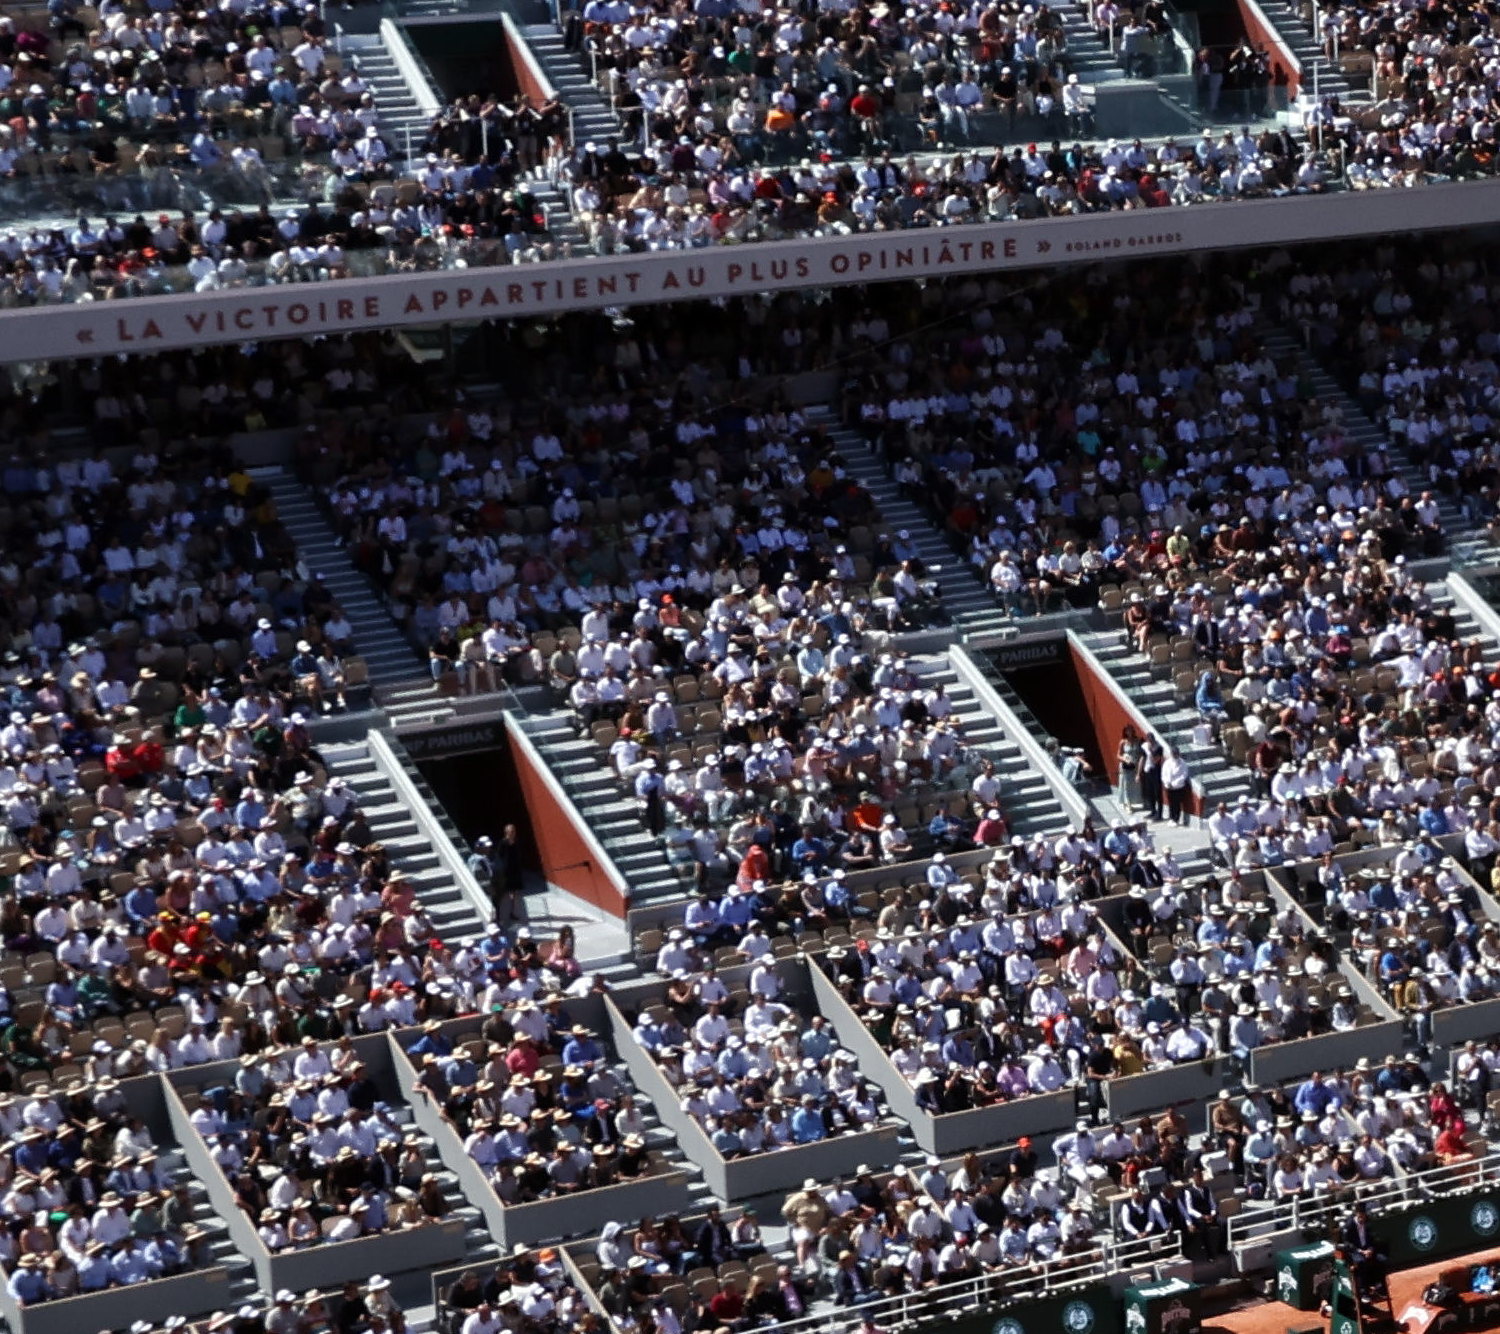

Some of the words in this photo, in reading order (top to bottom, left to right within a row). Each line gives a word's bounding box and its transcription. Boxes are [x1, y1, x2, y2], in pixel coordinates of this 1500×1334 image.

[118, 318, 163, 343] LA
[186, 295, 382, 334] VICTOIRE
[404, 272, 642, 316] APPARTIENT
[661, 265, 704, 291] AU
[727, 256, 810, 285] PLUS
[829, 237, 1019, 275] OPINIÂTRE
